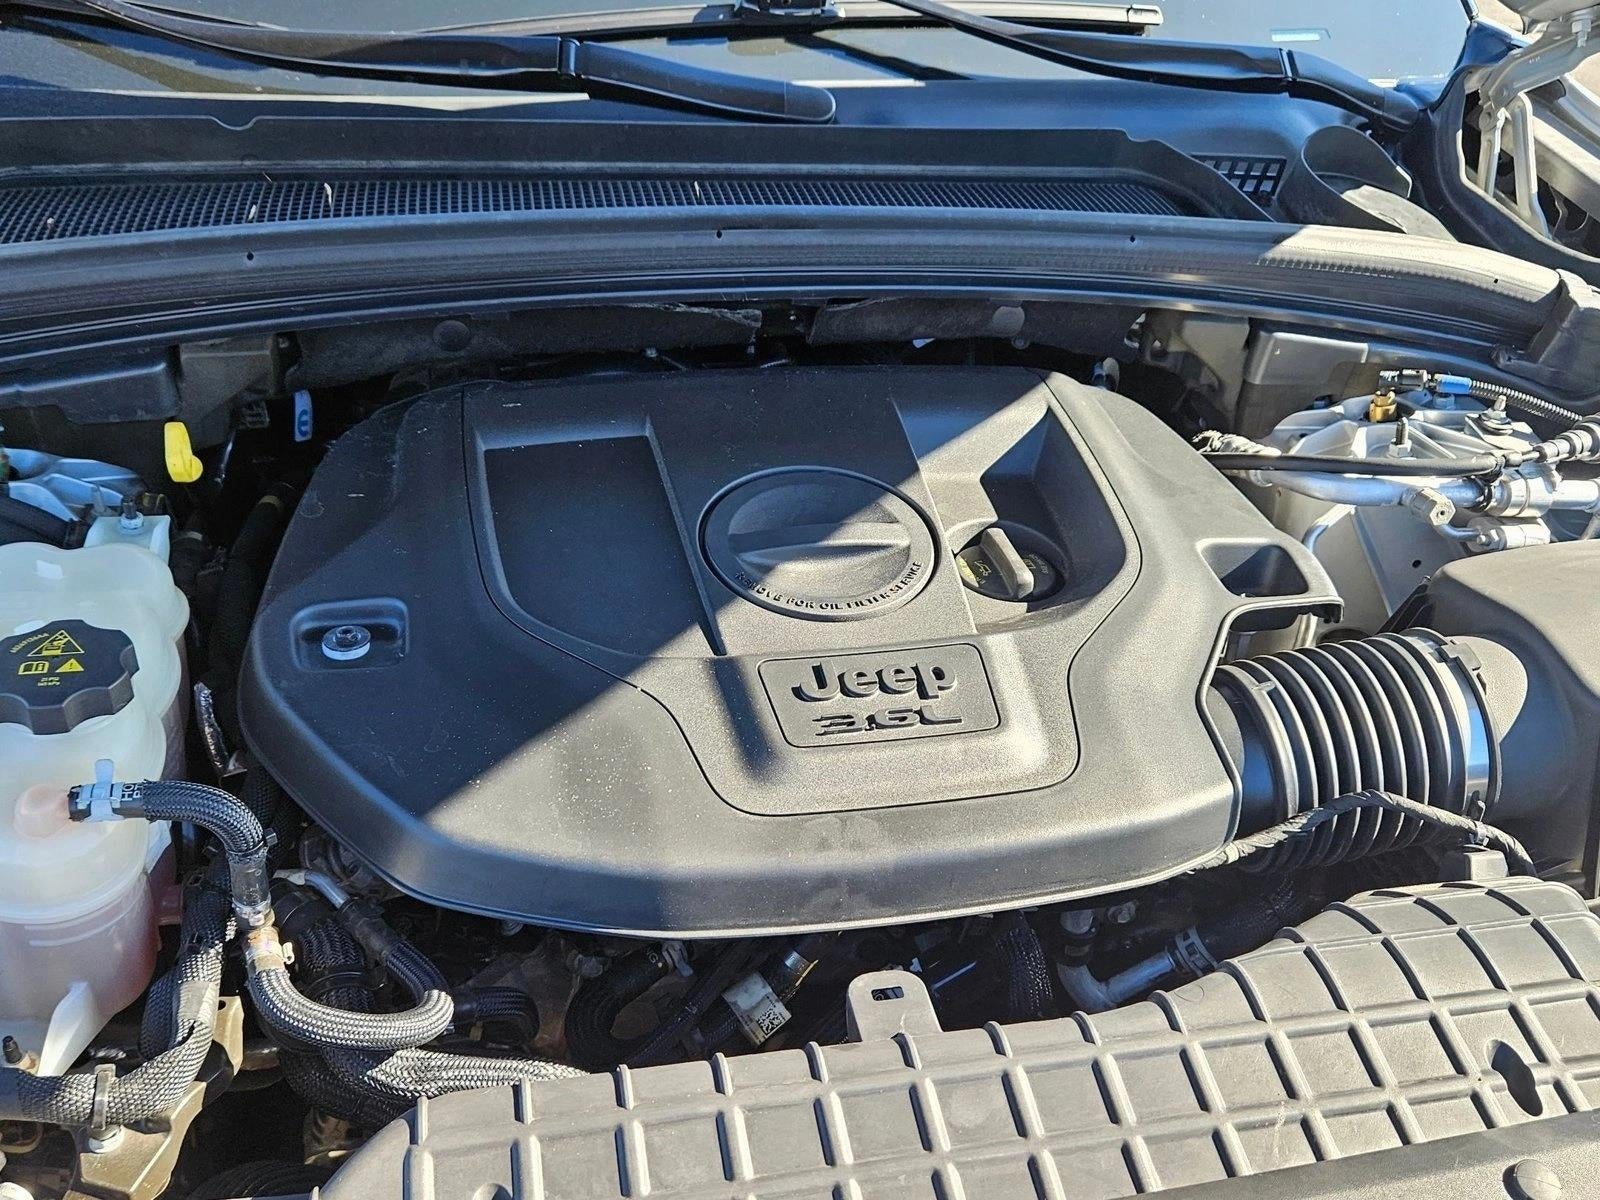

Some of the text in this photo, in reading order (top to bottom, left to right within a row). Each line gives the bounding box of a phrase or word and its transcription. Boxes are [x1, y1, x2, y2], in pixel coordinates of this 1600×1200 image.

[735, 561, 922, 610] REMOVE FOR OIL FILTER SERVICE
[791, 661, 957, 702] Jeep
[812, 704, 963, 737] 3.6L
